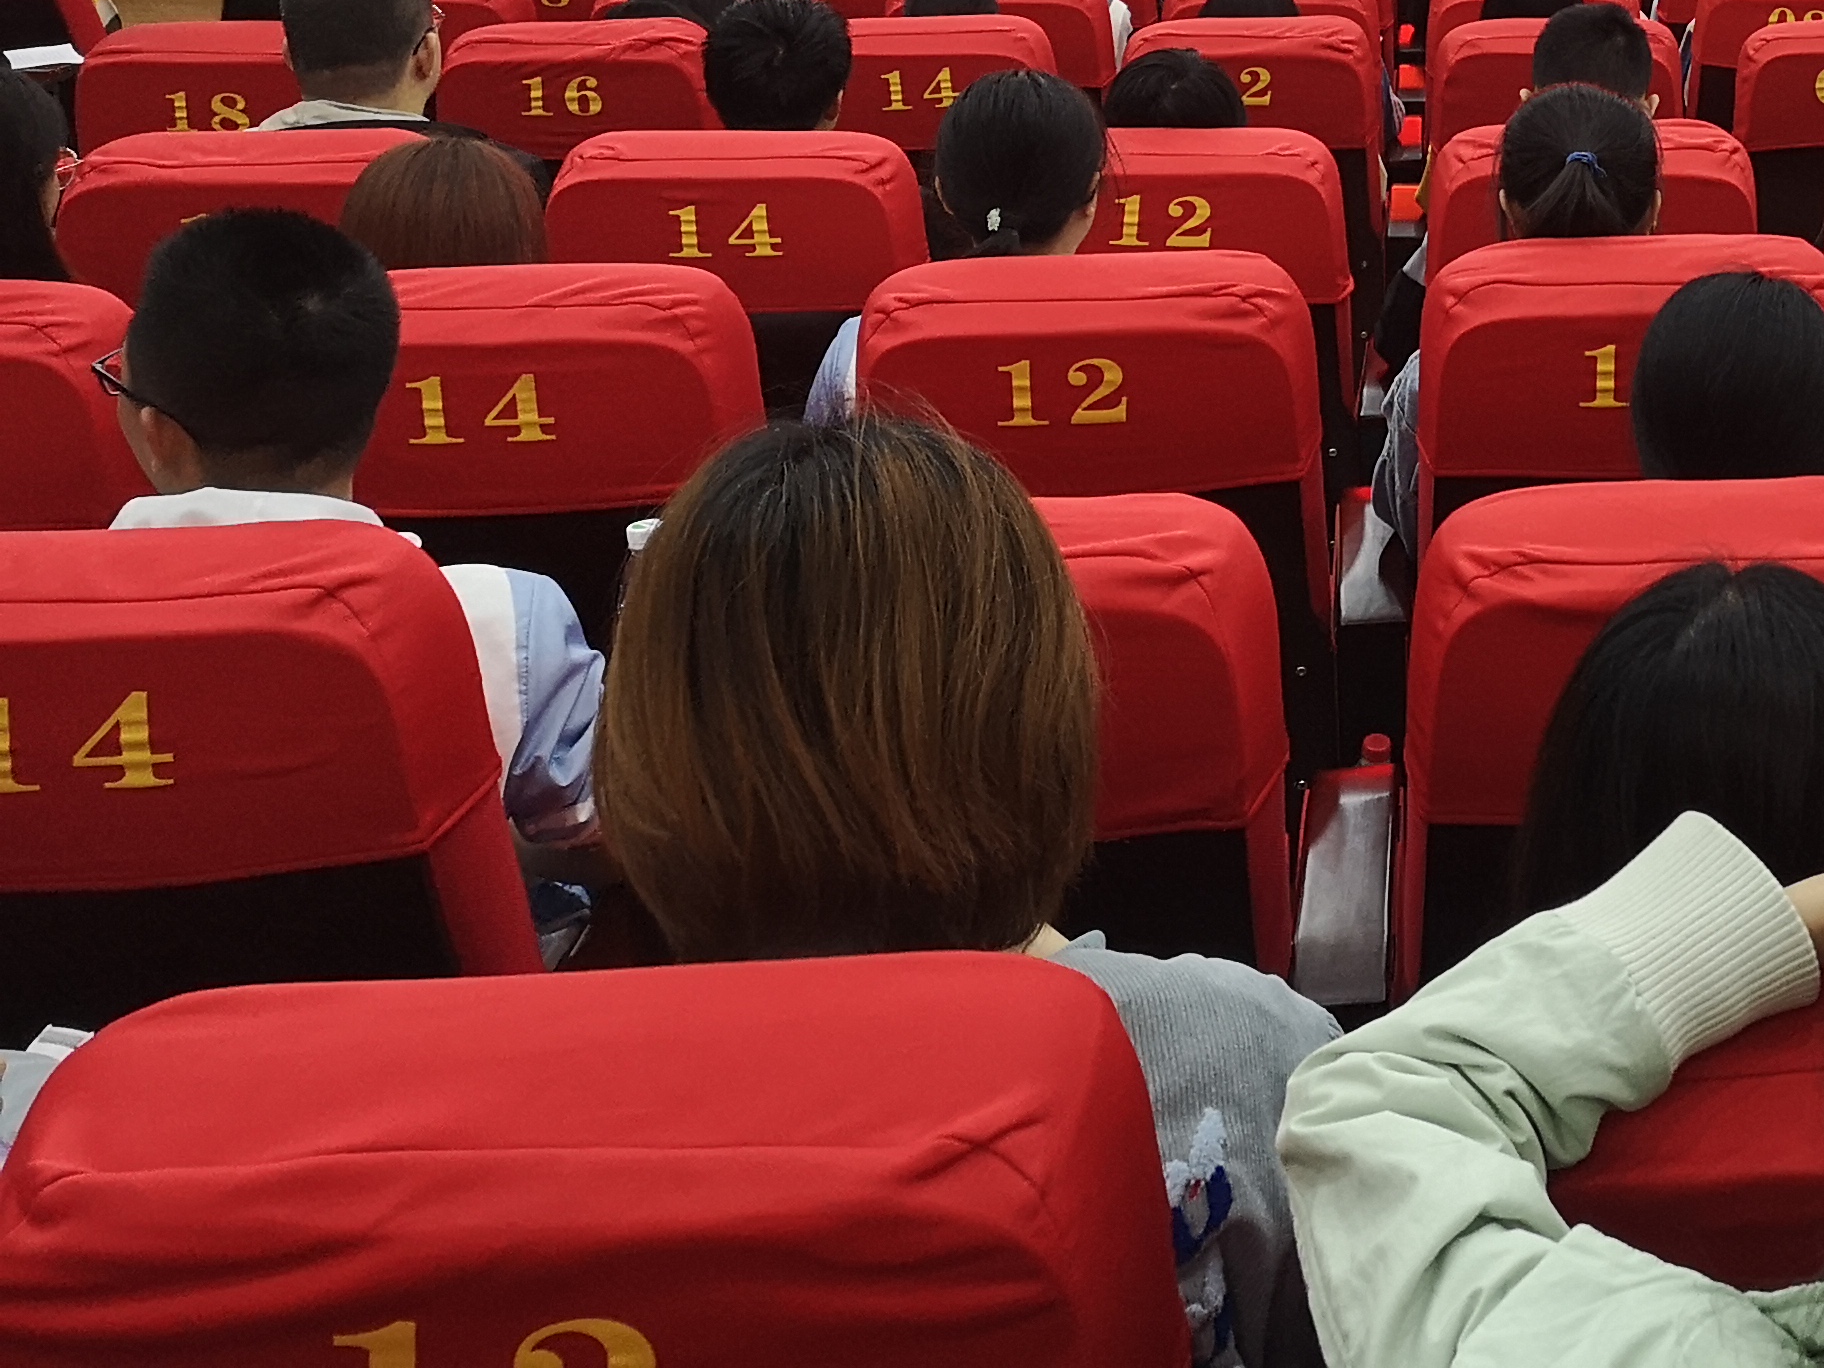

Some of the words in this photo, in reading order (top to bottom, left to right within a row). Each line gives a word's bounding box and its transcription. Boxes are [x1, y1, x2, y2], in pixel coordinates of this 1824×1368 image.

[165, 90, 250, 133] 18
[520, 74, 604, 117] 16
[880, 65, 961, 112] 14
[1238, 65, 1273, 108] 2
[667, 202, 784, 259] 14
[1108, 192, 1214, 249] 12
[996, 357, 1129, 427] 12
[1580, 344, 1627, 408] 1
[405, 373, 557, 446] 14
